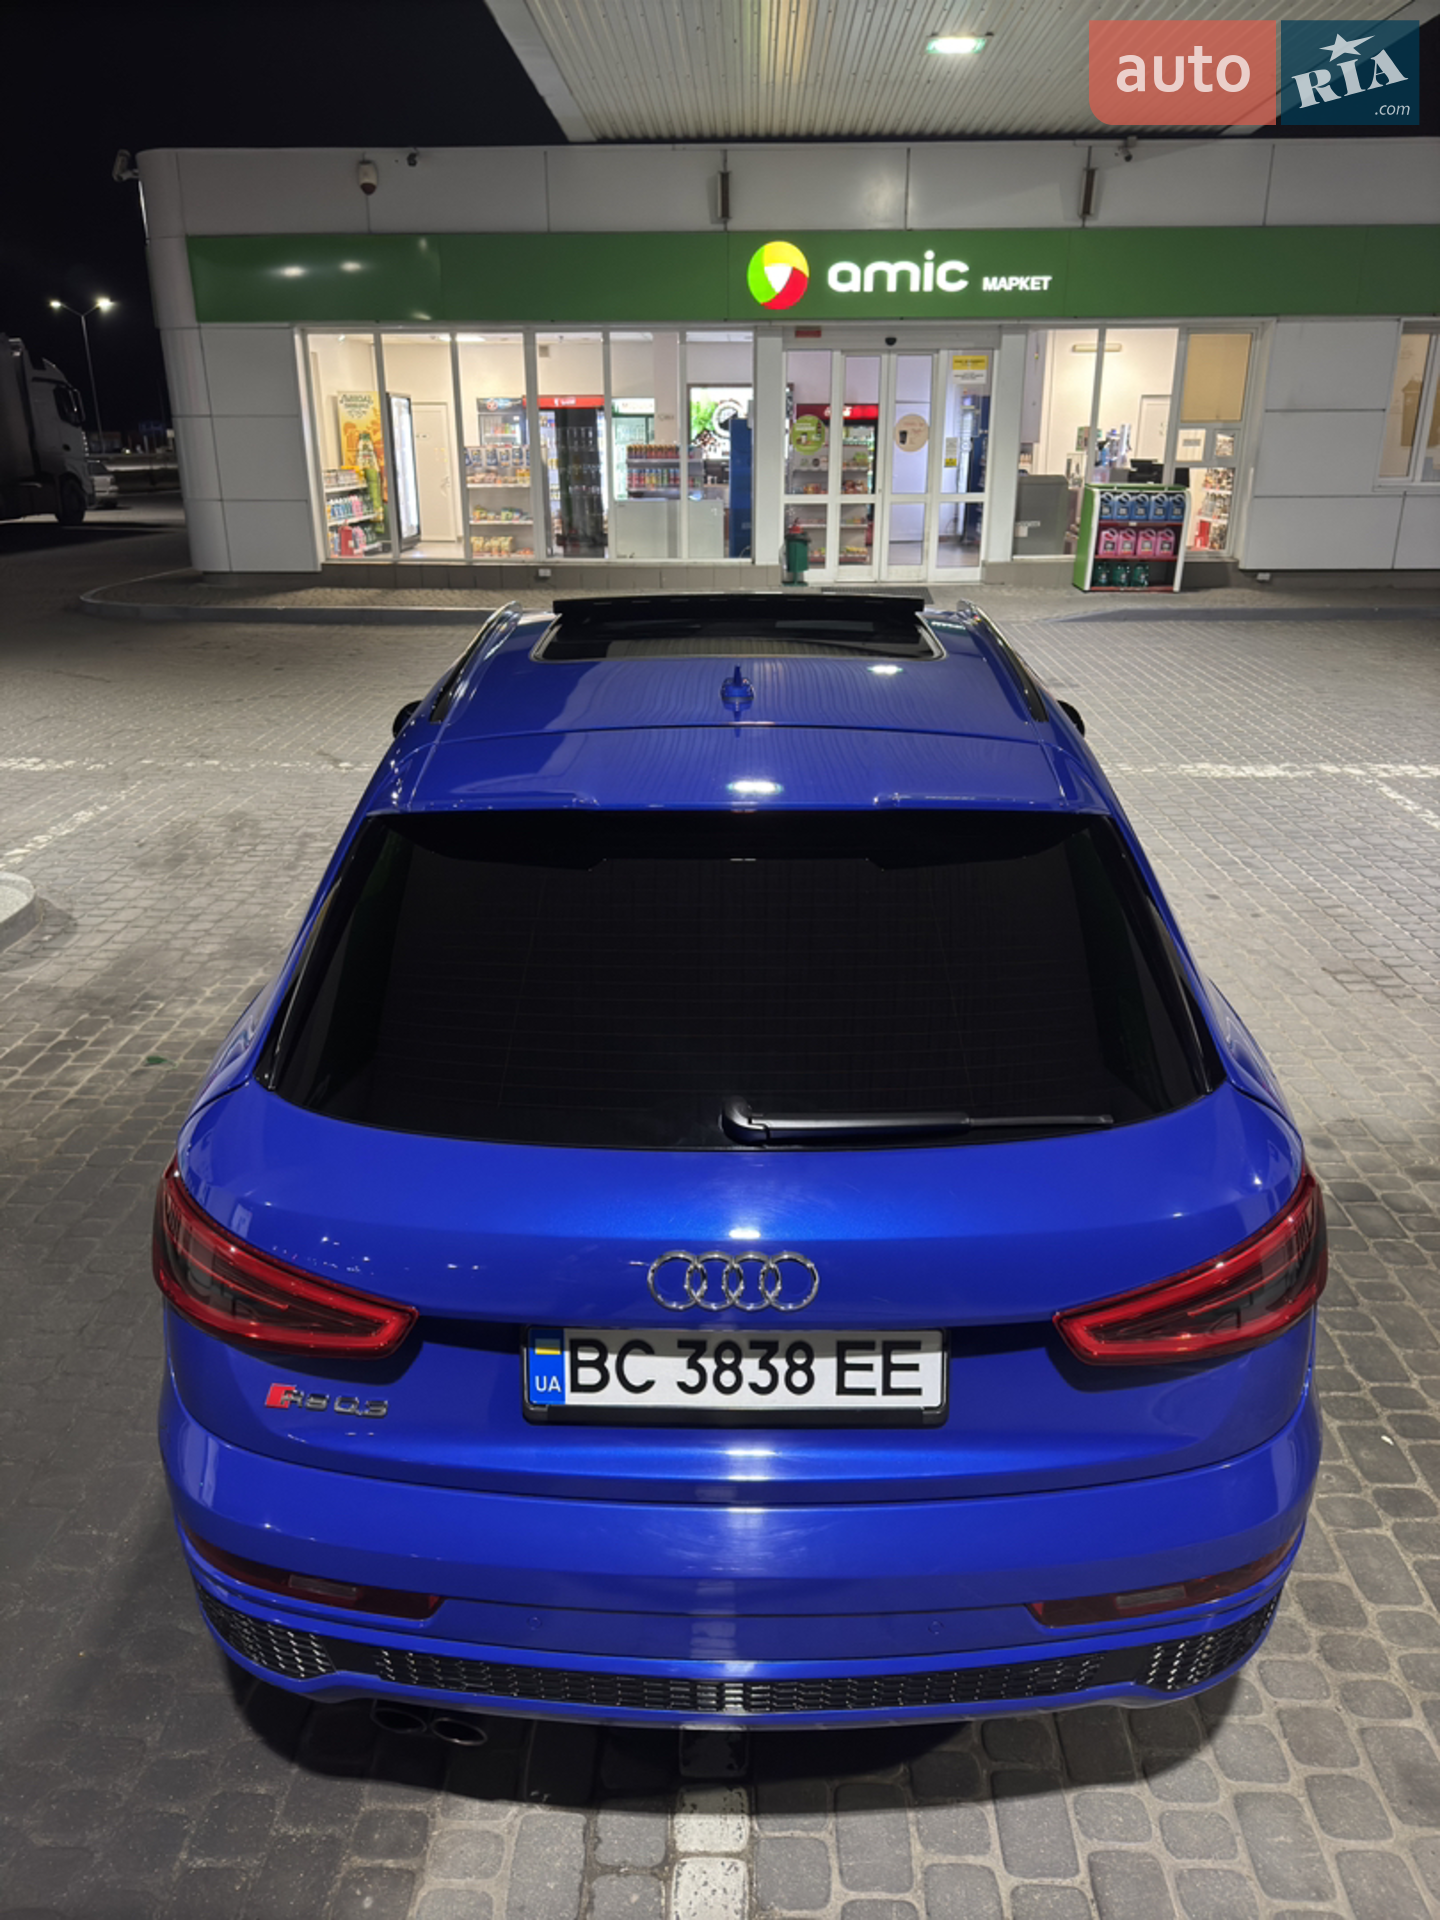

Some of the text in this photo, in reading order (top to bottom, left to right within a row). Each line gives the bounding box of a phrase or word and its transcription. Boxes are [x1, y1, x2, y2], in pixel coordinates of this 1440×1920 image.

[827, 250, 970, 293] amic
[982, 275, 1052, 292] МАРКЕТ
[569, 1338, 922, 1396] BC 3838 EE
[535, 1375, 561, 1393] UA
[333, 1395, 389, 1419] Q3
